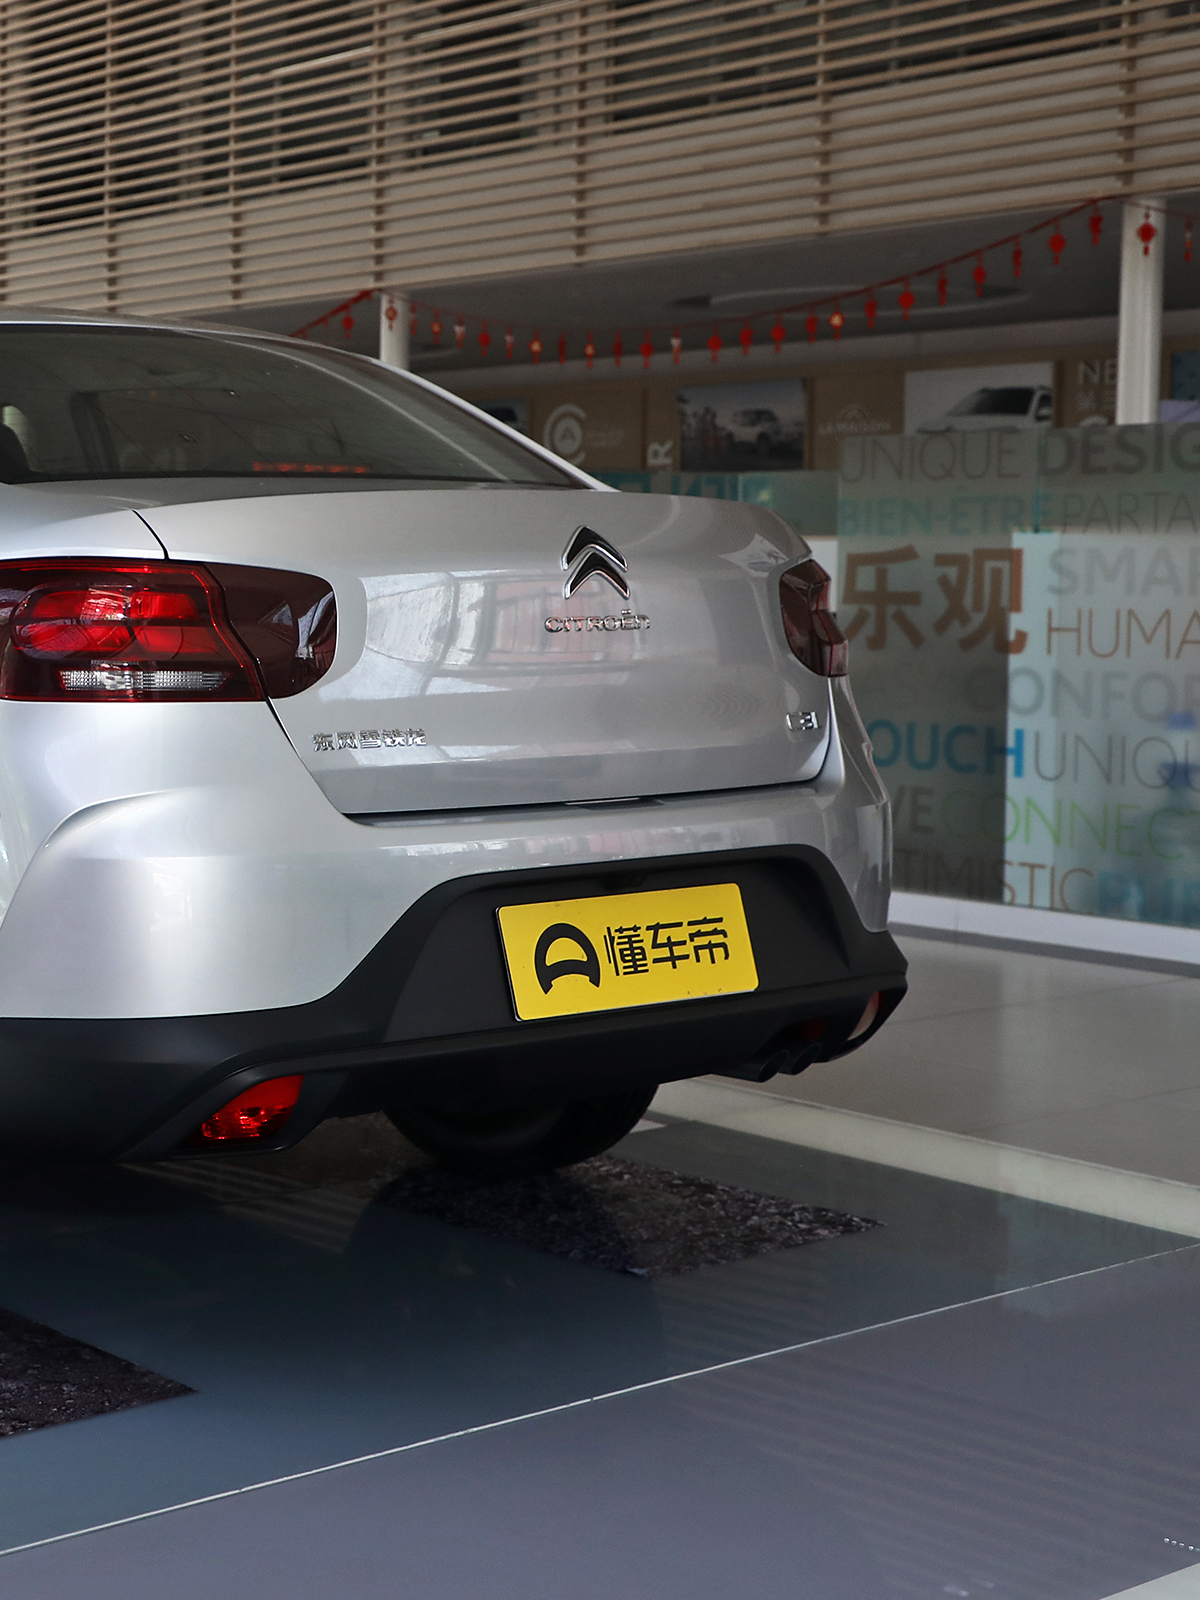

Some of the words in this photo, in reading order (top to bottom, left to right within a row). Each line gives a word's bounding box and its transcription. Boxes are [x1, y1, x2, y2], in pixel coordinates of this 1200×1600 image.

[842, 543, 1028, 654] 乐观
[311, 728, 427, 752] 东风雪铁龙
[866, 717, 1025, 778] OUCH
[940, 788, 1200, 860] CONNEC
[604, 916, 730, 976] 懂车帝
